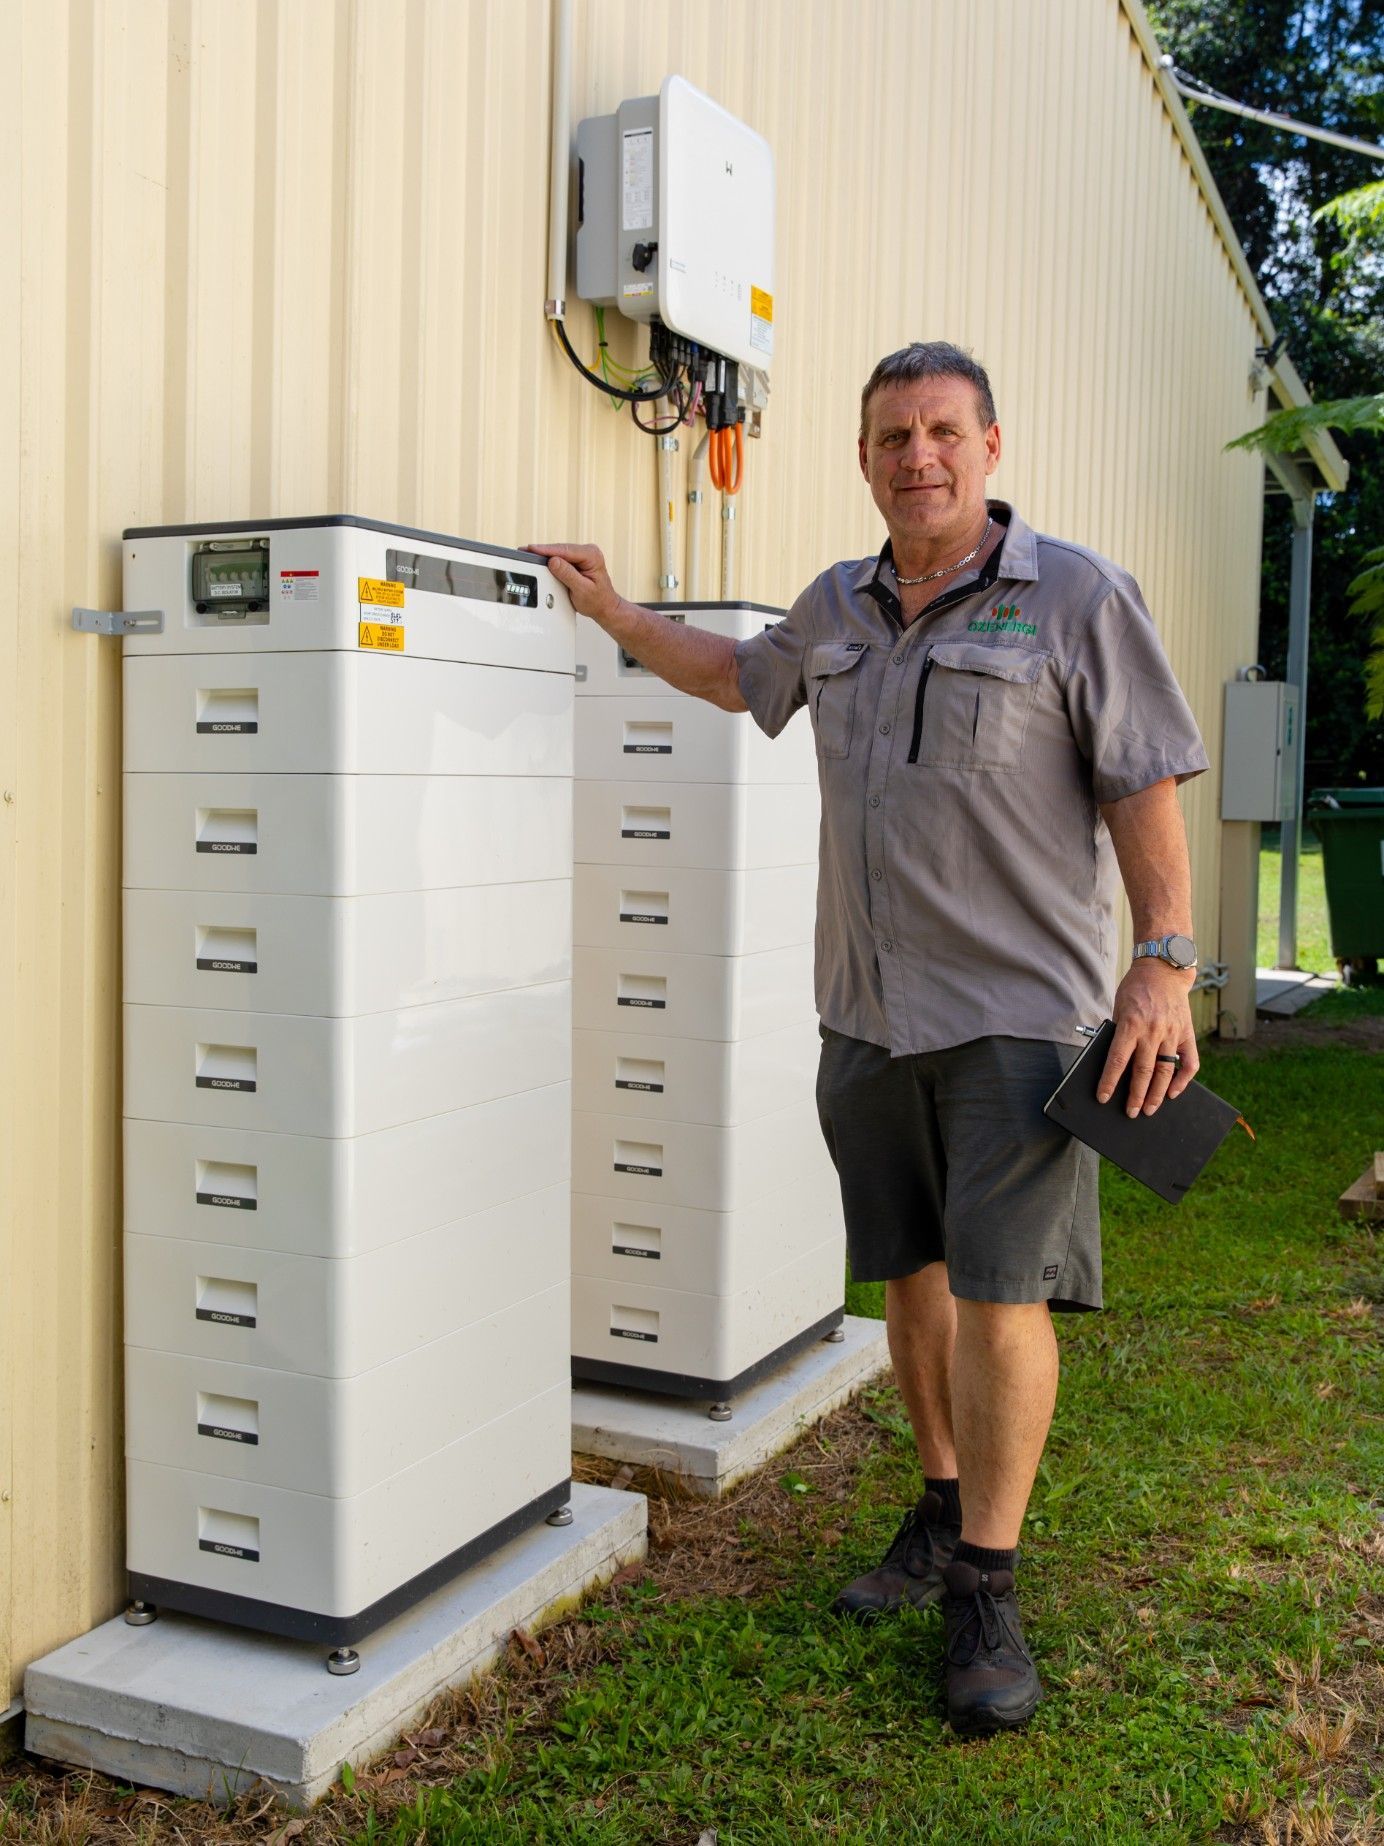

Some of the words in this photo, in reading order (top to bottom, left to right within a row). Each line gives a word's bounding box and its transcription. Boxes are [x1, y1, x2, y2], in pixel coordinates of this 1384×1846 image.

[396, 565, 420, 576] GOODWE
[212, 724, 242, 732] GOODWE
[211, 843, 241, 852] GOODWE
[212, 961, 241, 970] GOODWE
[211, 1079, 240, 1089] GOODWE
[211, 1196, 241, 1207] GOODWE
[211, 1312, 240, 1324] GOODWE
[213, 1428, 242, 1440] GOODWE
[214, 1545, 243, 1557] GOODWE
